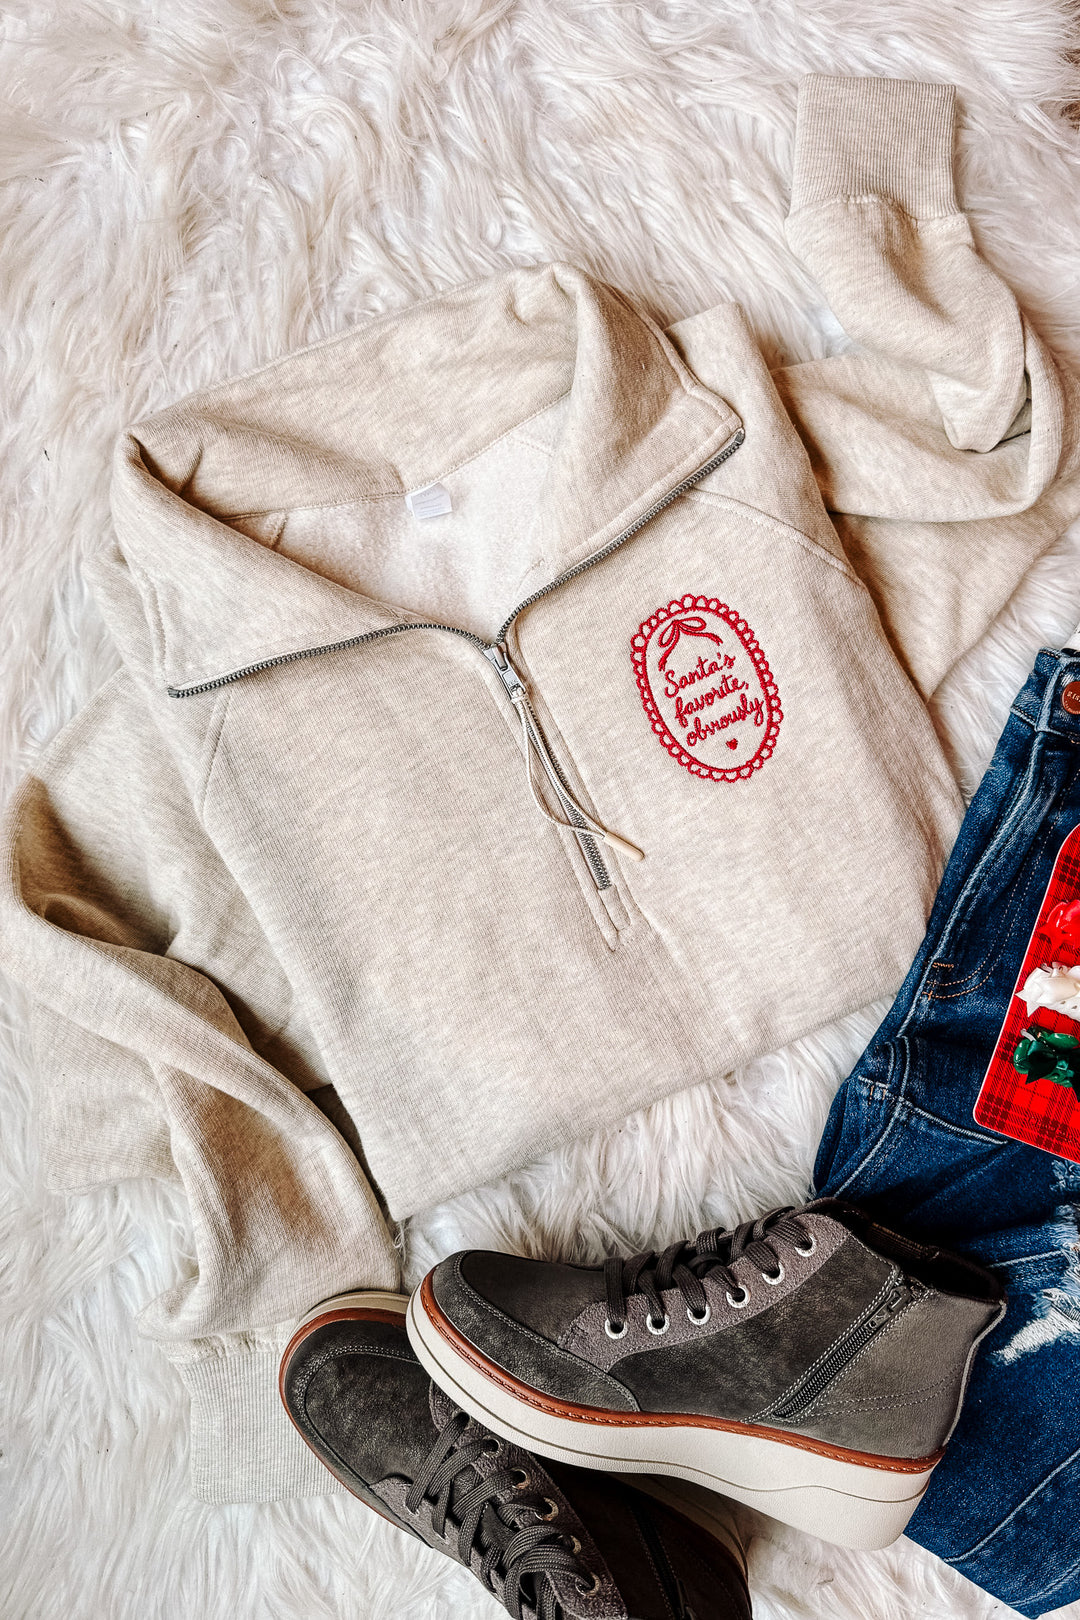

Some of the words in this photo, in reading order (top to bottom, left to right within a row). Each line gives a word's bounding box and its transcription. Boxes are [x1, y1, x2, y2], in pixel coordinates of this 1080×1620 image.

[665, 652, 735, 698] Santa's
[675, 675, 749, 728] favorite,
[686, 693, 764, 746] obviously
